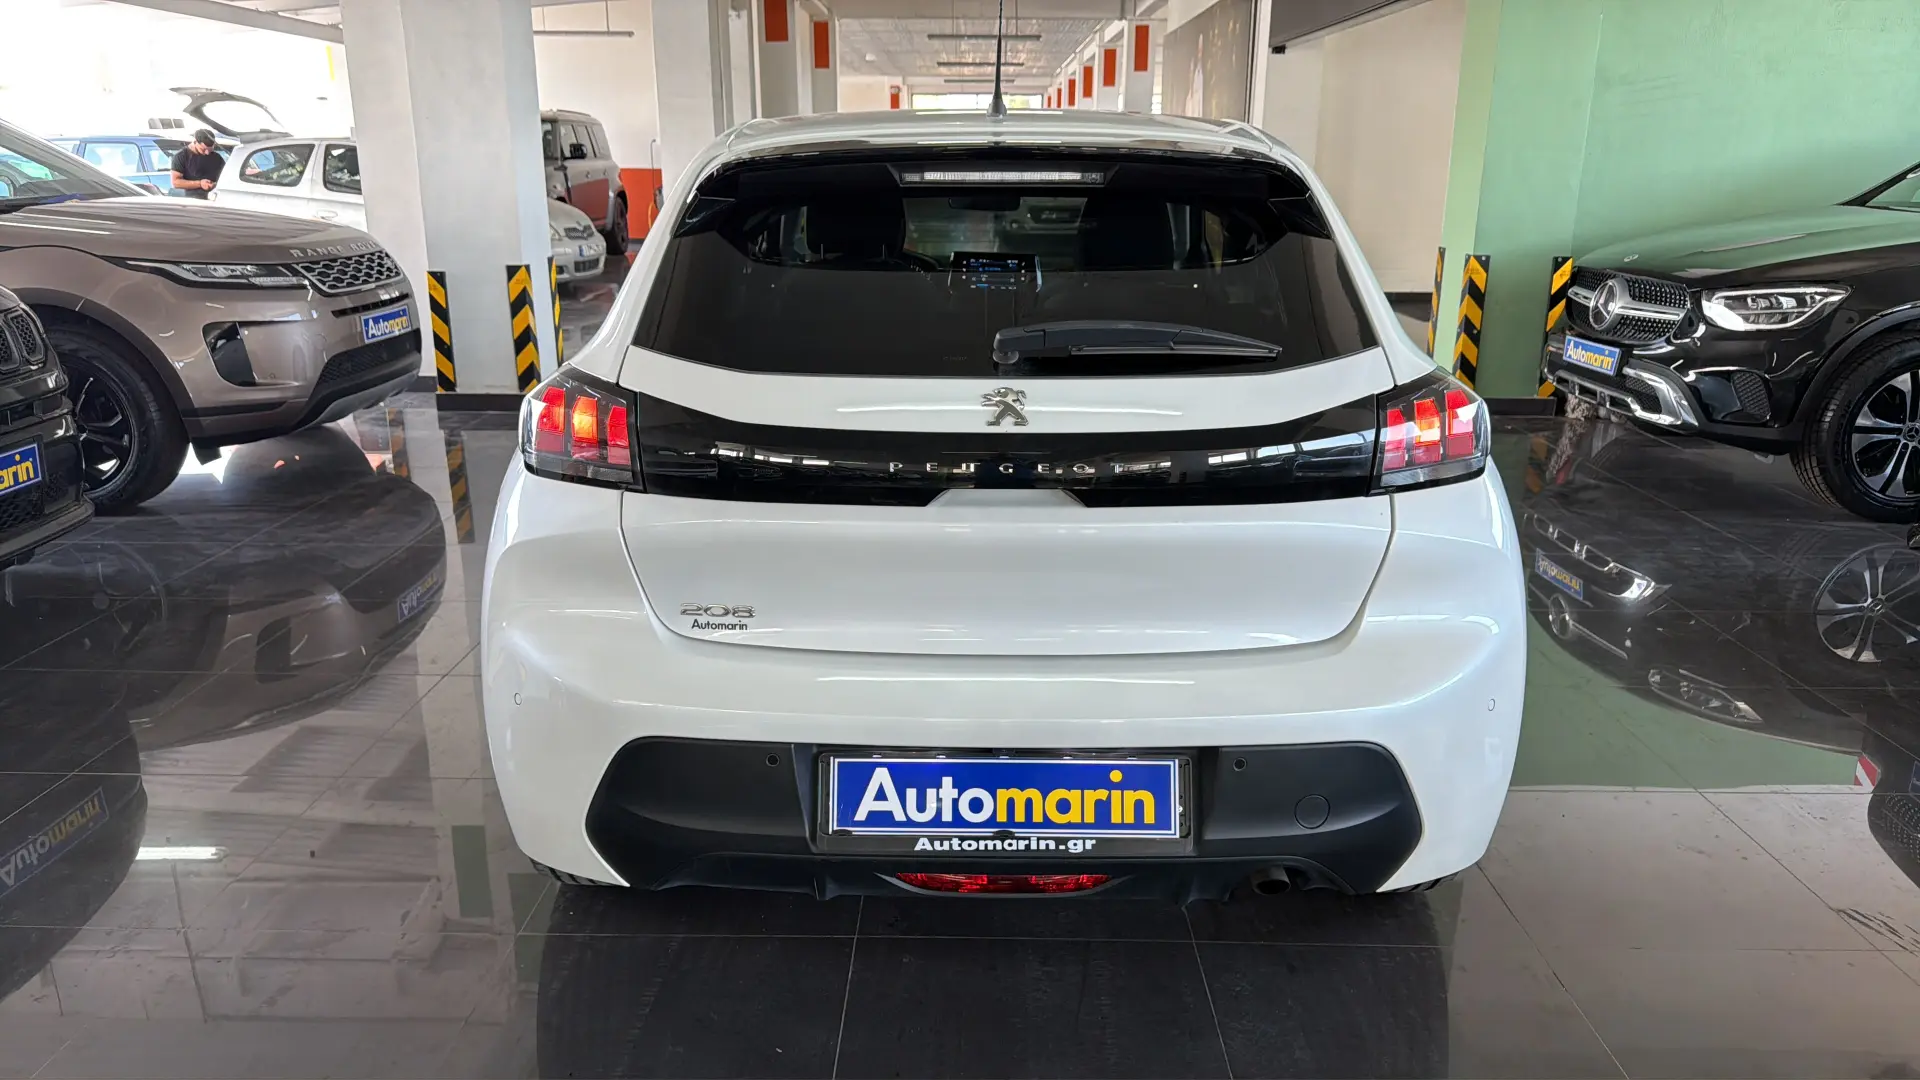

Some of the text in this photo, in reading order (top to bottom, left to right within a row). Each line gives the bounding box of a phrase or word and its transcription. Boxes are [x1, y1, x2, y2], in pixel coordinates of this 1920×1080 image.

[368, 311, 408, 338] Automarin
[1566, 340, 1613, 370] Automarin
[889, 462, 1125, 474] PEUGEOT
[680, 602, 757, 618] 208
[691, 618, 748, 631] Automarin
[853, 766, 1156, 824] Automarin
[913, 836, 1096, 853] Automarin.gr
